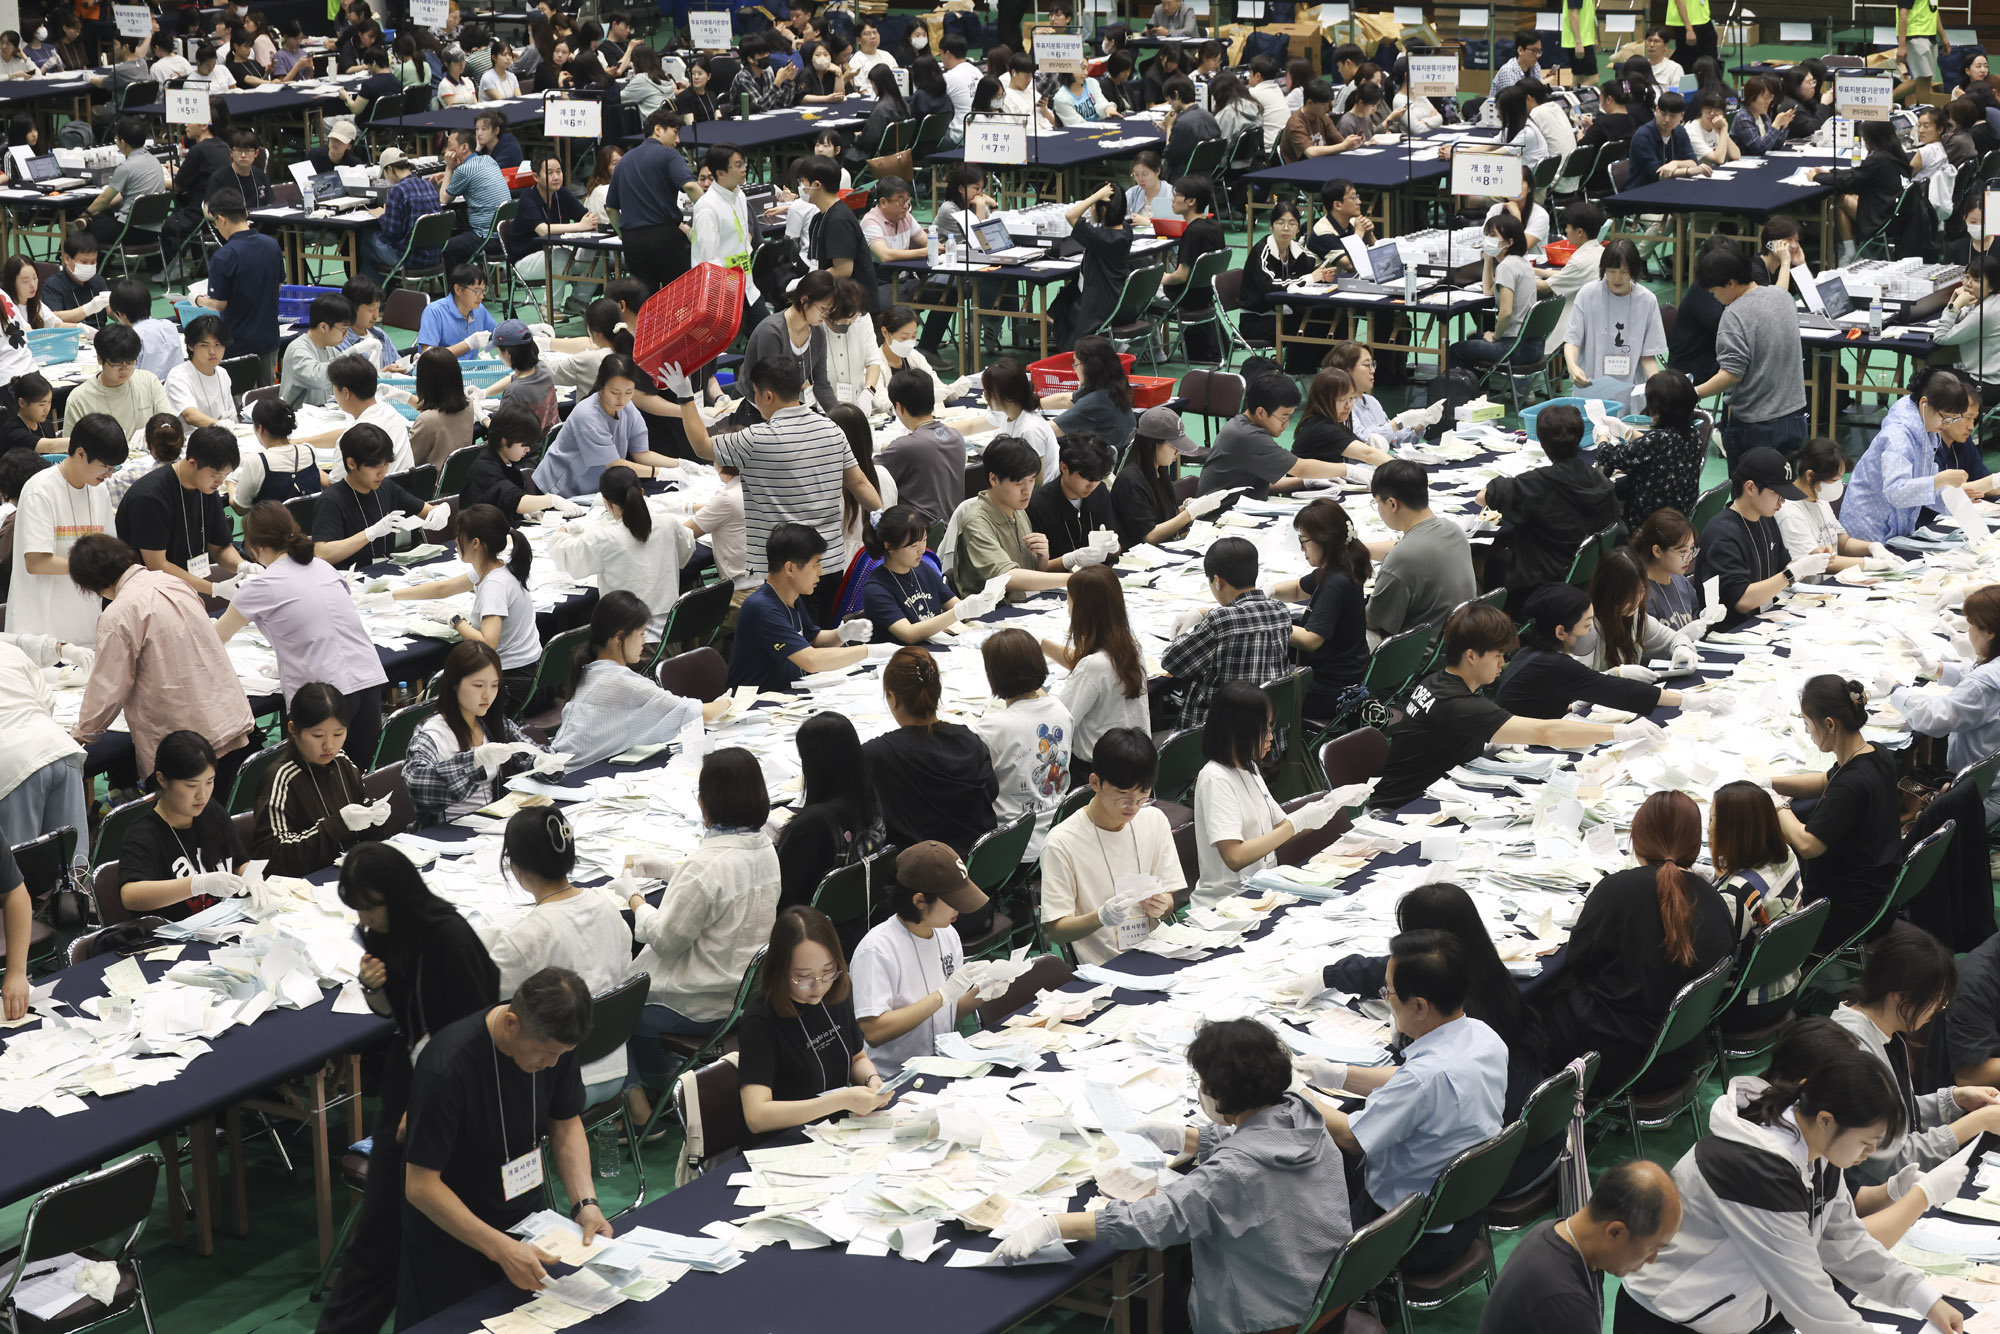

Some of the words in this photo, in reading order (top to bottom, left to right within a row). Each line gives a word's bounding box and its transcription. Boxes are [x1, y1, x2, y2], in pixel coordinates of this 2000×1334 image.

[691, 19, 729, 27] 투표지분류기운영부
[1036, 42, 1081, 50] 투표지분류기운영부
[1411, 64, 1457, 72] 투표지분류기운영부
[1838, 85, 1891, 95] 투표지분류기운영부
[1120, 922, 1147, 932] 개표사무원
[507, 1157, 537, 1177] 개표사무원
